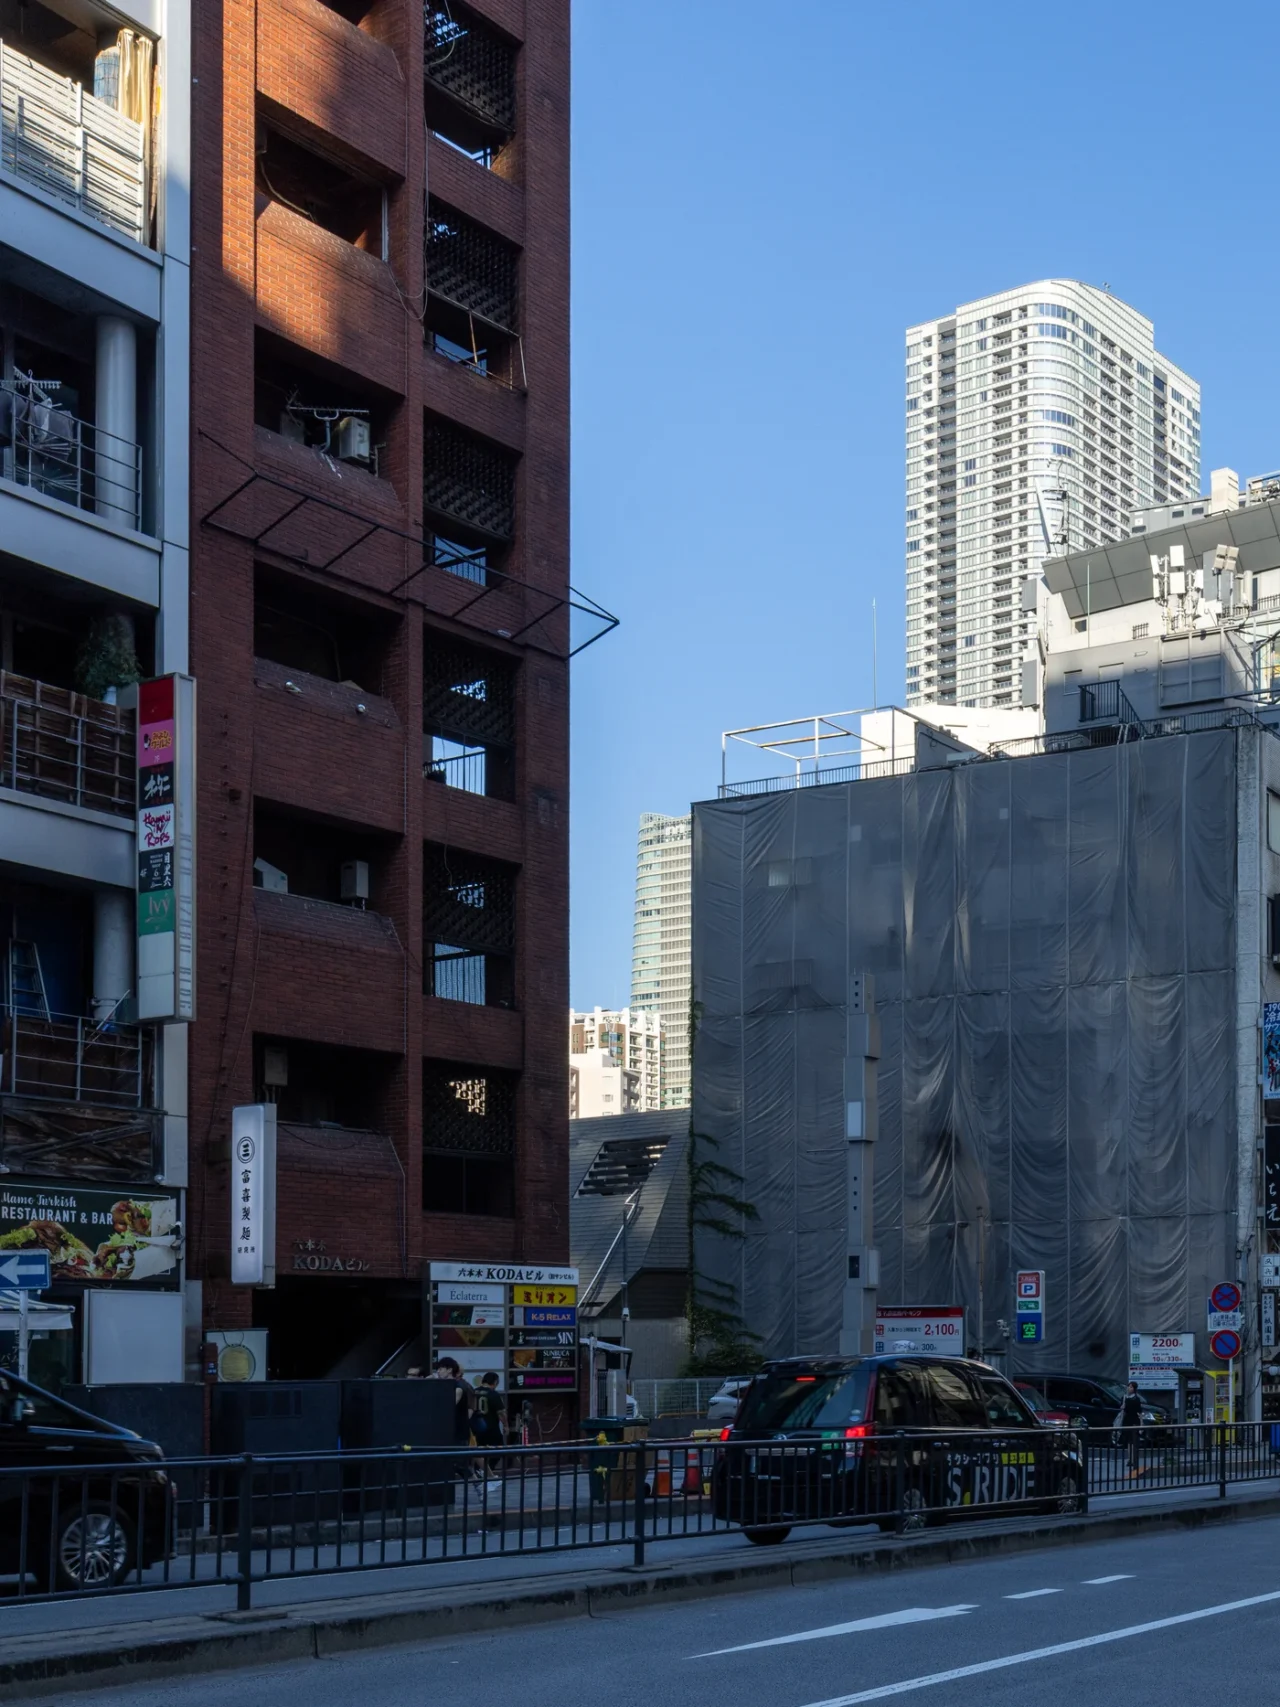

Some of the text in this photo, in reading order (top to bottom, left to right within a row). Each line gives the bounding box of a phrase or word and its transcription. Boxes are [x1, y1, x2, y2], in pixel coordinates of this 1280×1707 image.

[37, 1194, 77, 1208] Turkish
[1, 1206, 114, 1226] RESTAURANT & BAR
[292, 1239, 327, 1251] 六本木
[292, 1255, 369, 1271] KODAビル
[458, 1268, 483, 1278] 六本木
[486, 1268, 544, 1281] KODAビル
[450, 1289, 488, 1301] Éclaterra
[1024, 1285, 1033, 1293] P
[523, 1291, 567, 1303] ミリオン
[924, 1324, 959, 1336] 2,100円
[1023, 1323, 1036, 1339] 空
[557, 1332, 574, 1345] SIN
